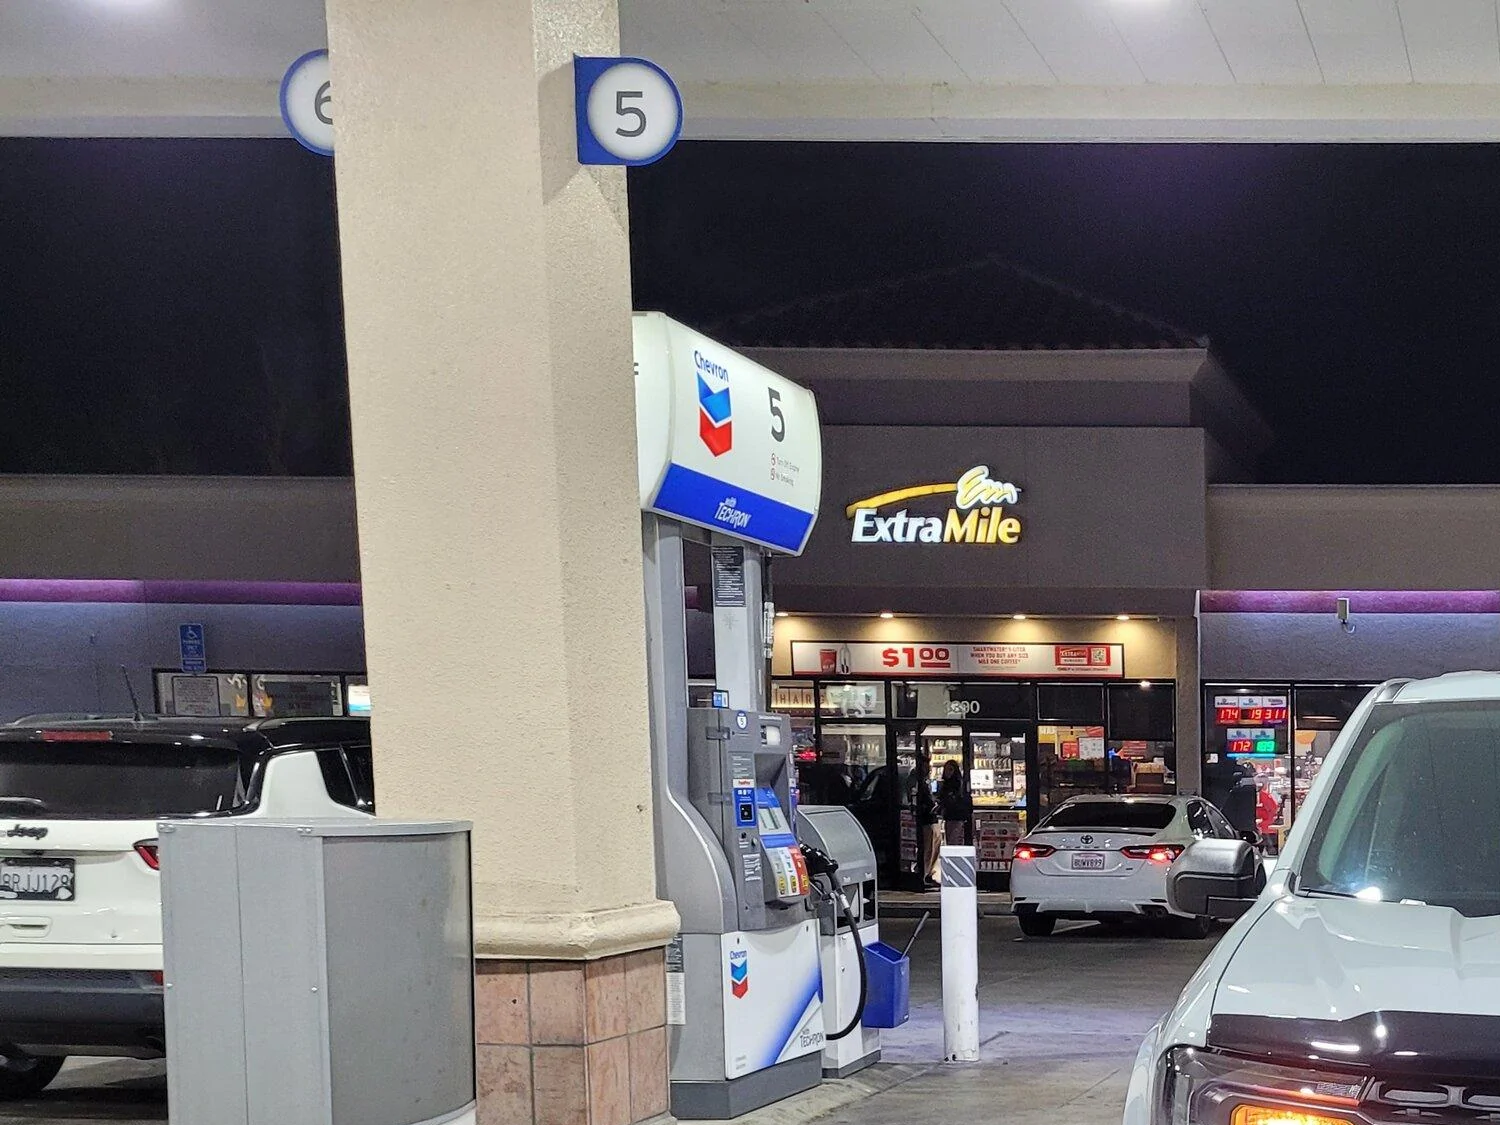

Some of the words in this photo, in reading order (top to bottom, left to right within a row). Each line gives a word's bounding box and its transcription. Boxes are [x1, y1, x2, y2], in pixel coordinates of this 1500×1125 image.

[615, 90, 647, 138] 5
[694, 350, 729, 383] Chevron
[767, 387, 785, 443] 5
[714, 502, 752, 529] TECHRON
[851, 506, 1022, 544] ExtraMile
